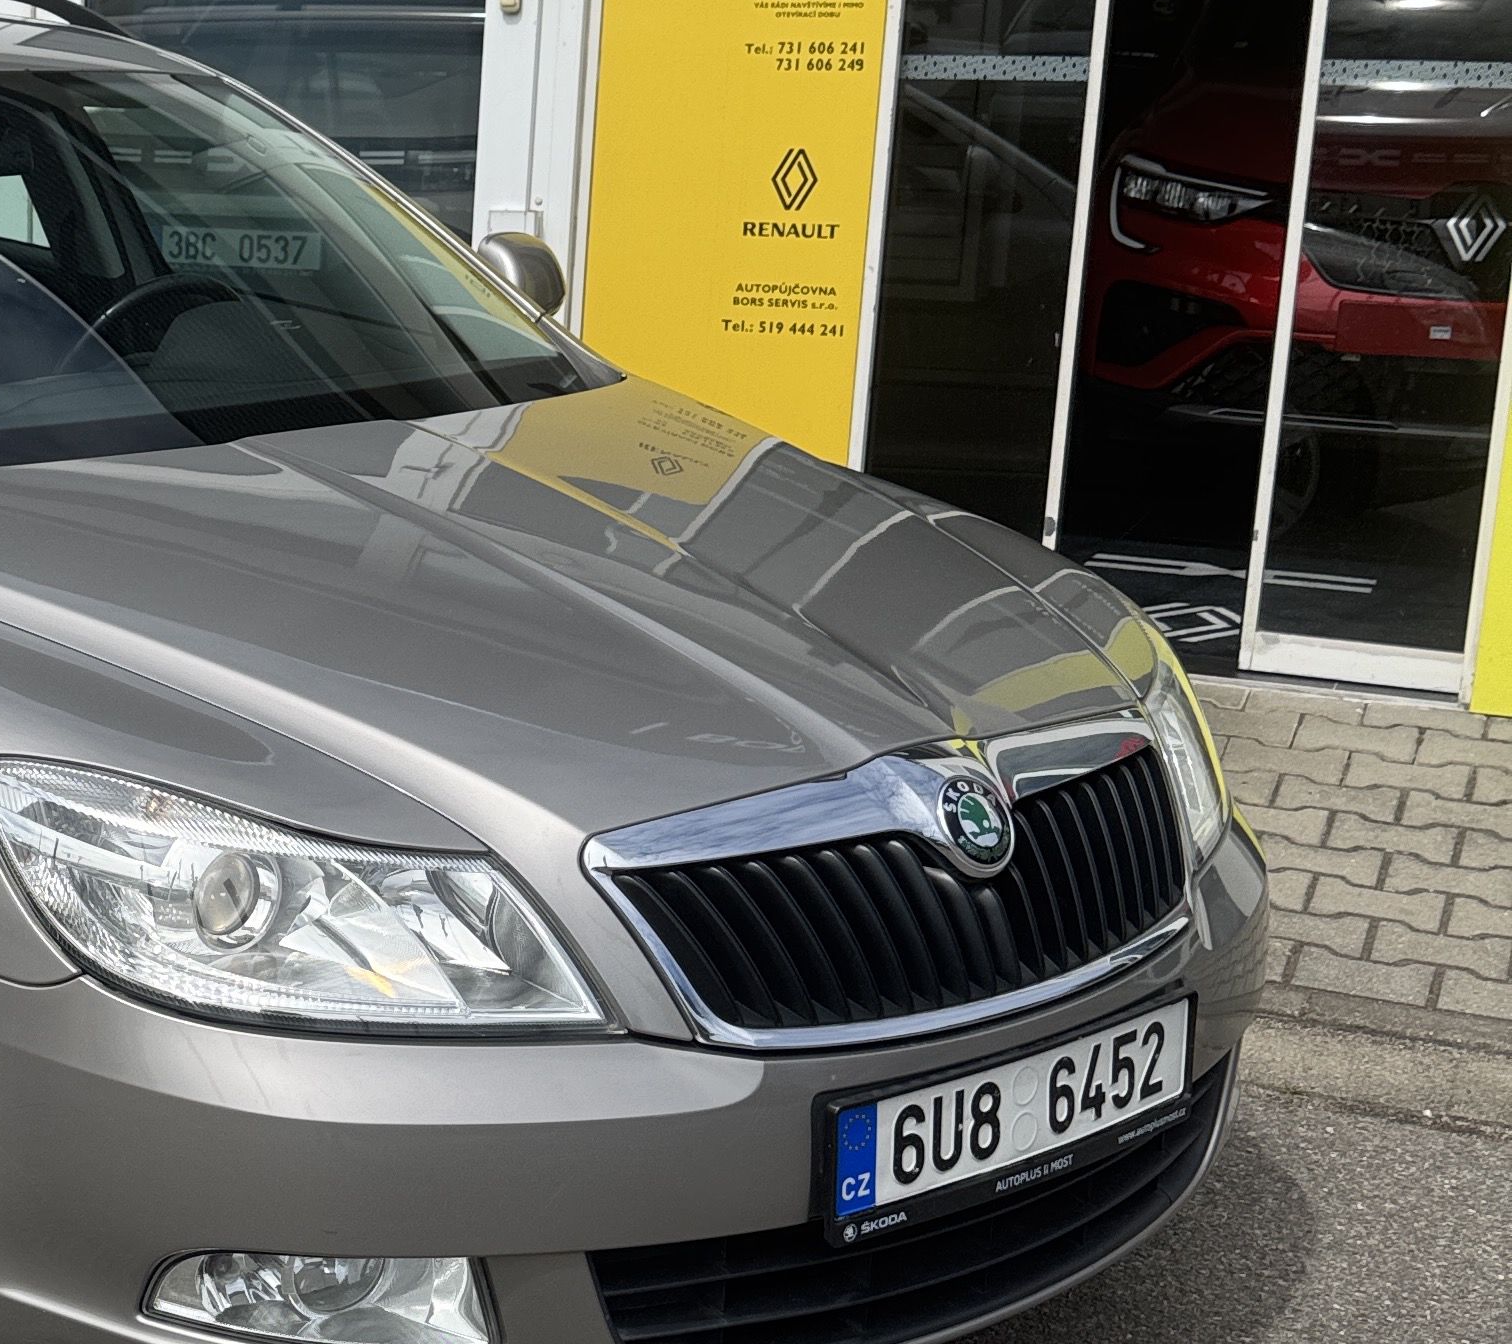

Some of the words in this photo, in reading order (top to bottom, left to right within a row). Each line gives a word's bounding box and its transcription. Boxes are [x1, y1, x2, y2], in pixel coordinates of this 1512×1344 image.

[744, 42, 774, 55] Tel.:
[777, 41, 802, 55] 731
[808, 41, 835, 55] 606
[839, 41, 865, 55] 241
[775, 58, 800, 71] 731
[806, 58, 833, 71] 606
[838, 58, 864, 71] 249
[742, 221, 840, 240] RENAULT
[168, 230, 217, 261] 3BC
[239, 233, 308, 265] 0537
[732, 296, 764, 307] BORS
[767, 296, 808, 309] SERVIS
[721, 318, 755, 333] Tel.:
[758, 320, 785, 335] 519
[789, 322, 815, 336] 444
[819, 323, 845, 338] 241
[891, 1080, 1002, 1186] 6U8
[1047, 1020, 1166, 1135] 6452
[995, 1165, 1043, 1193] AUTOPLUS
[1050, 1153, 1074, 1173] MOST
[841, 1171, 871, 1201] CZ
[860, 1211, 908, 1235] ŠKODA
